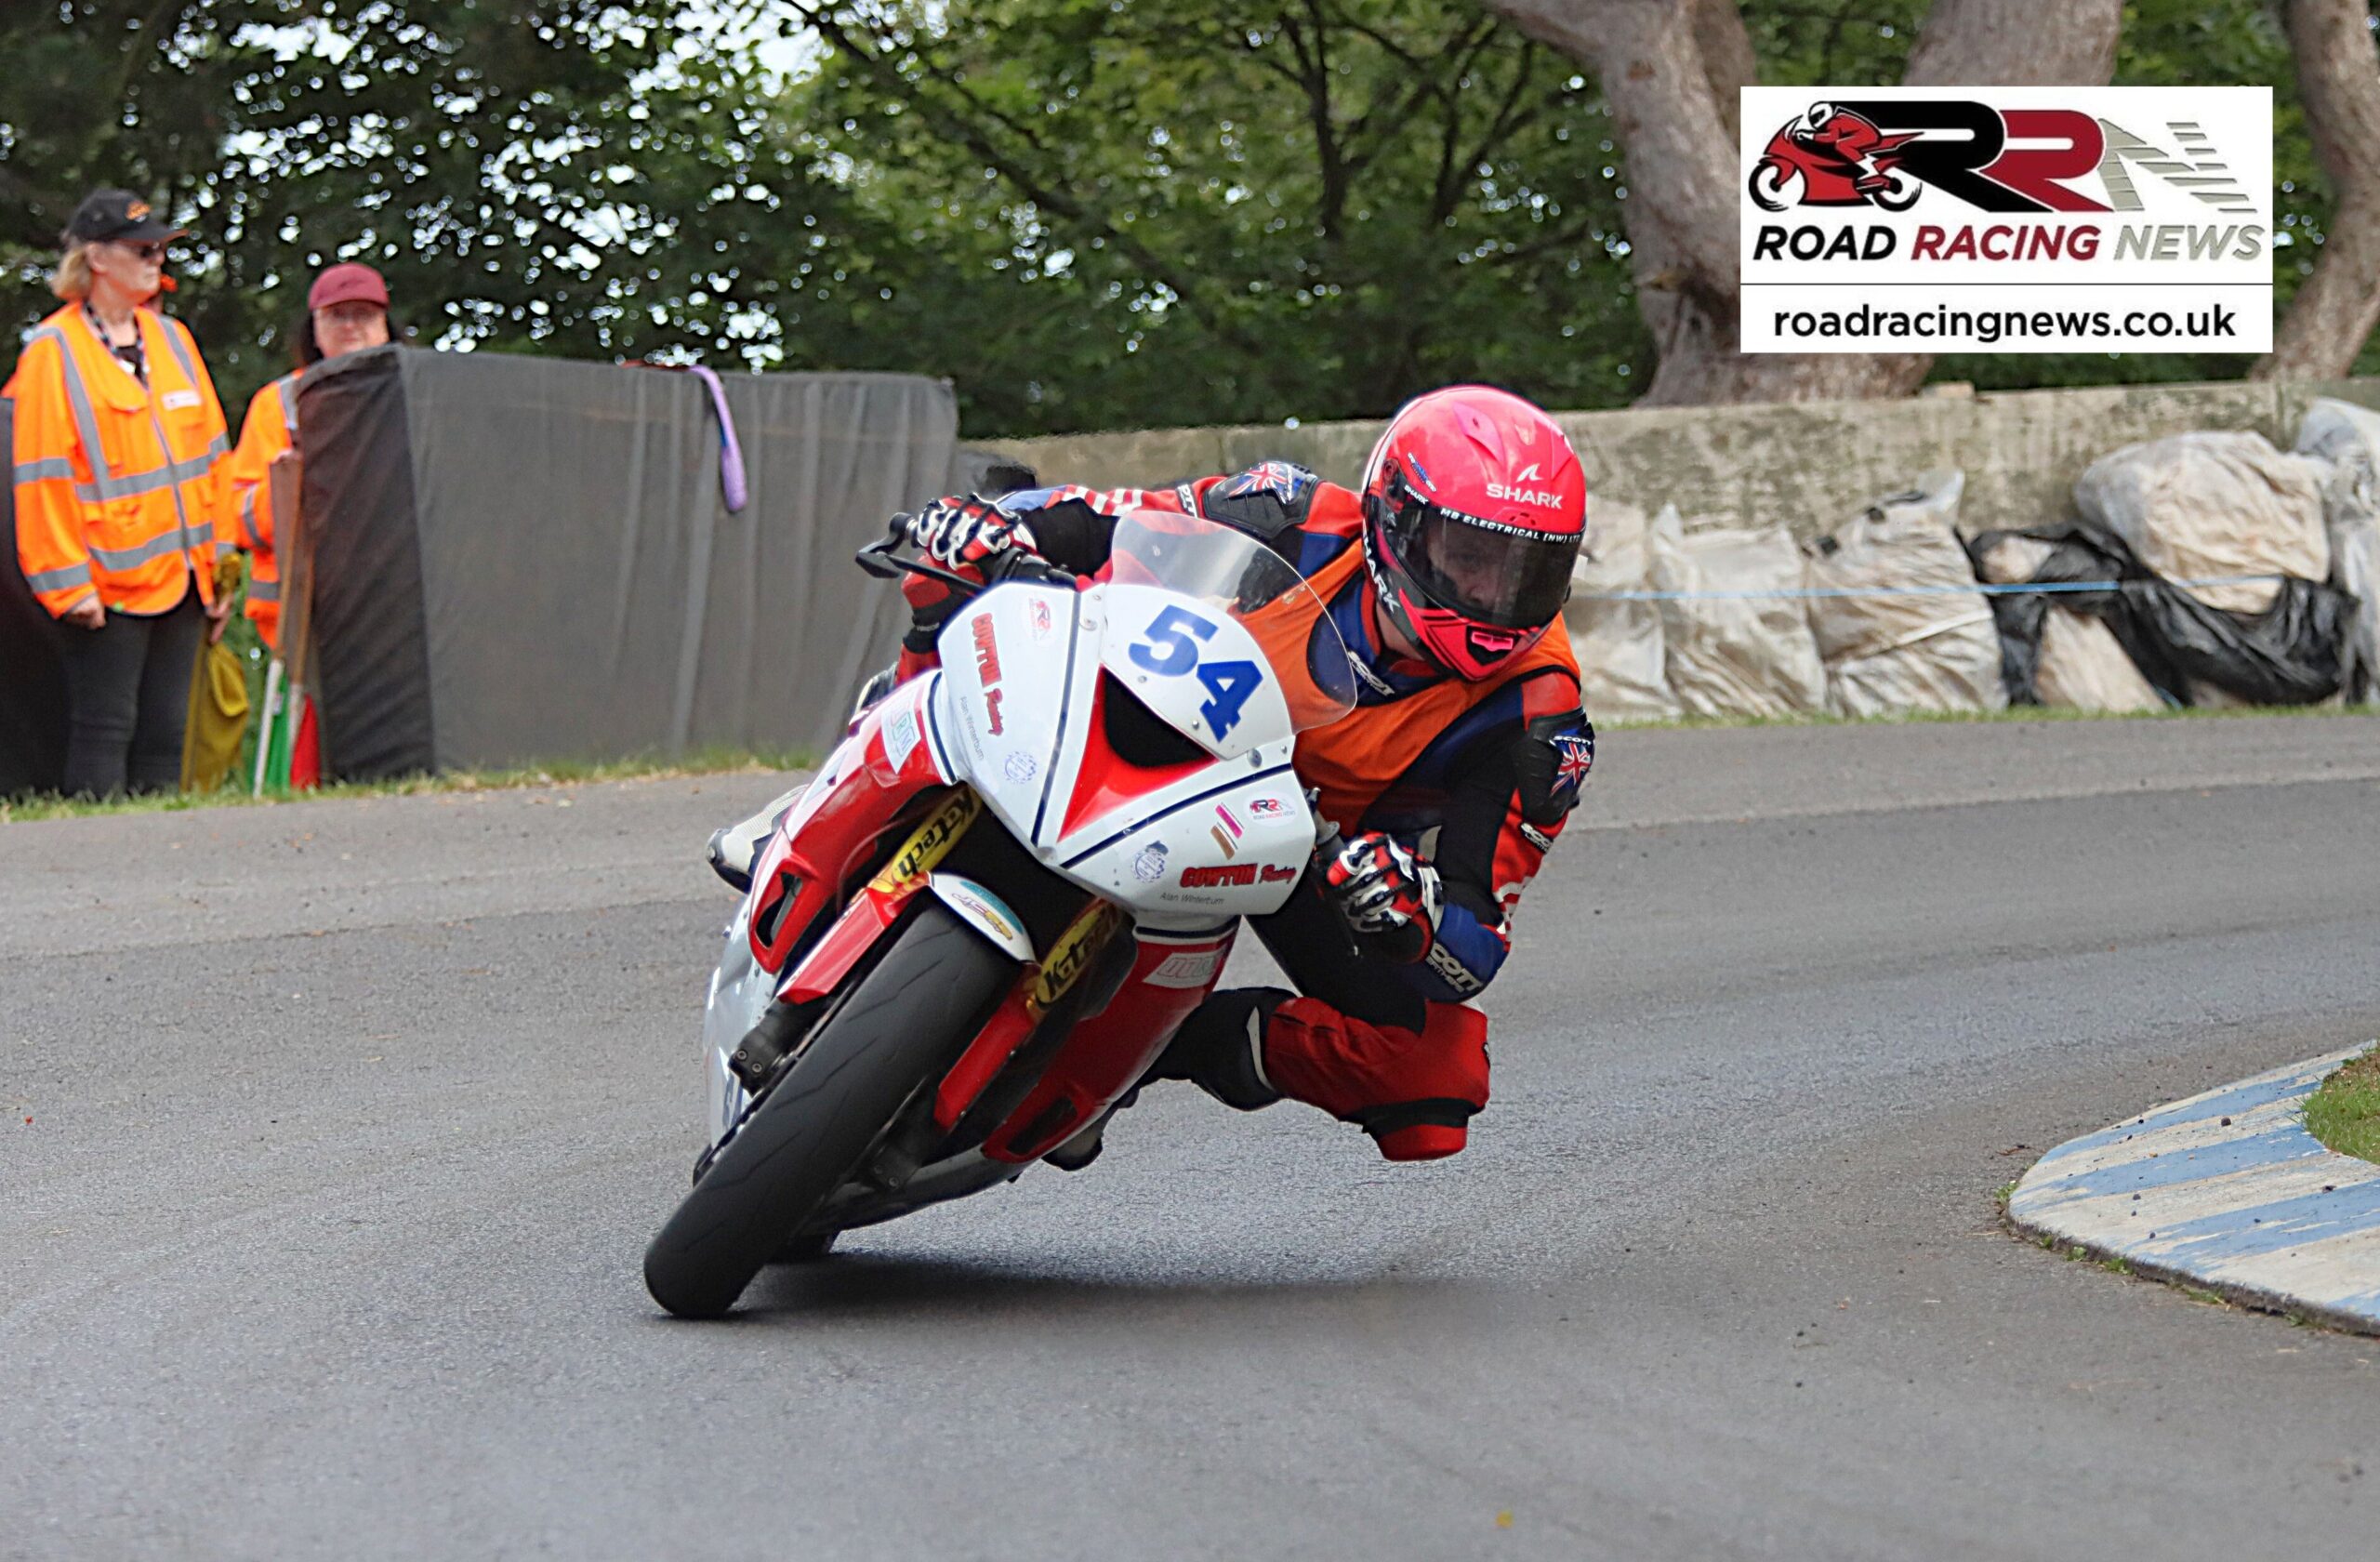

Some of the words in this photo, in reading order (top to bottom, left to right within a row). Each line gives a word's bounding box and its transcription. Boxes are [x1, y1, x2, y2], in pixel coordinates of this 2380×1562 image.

[1404, 483, 1429, 505] SHARK
[1486, 483, 1564, 510] SHARK
[1439, 507, 1460, 521] MB
[1461, 514, 1540, 540] ELECTRICAL
[1363, 536, 1401, 614] HARK
[1128, 603, 1264, 743] 54
[1179, 863, 1258, 889] COWTON
[1259, 863, 1298, 884] Racing
[1430, 942, 1484, 992] COTT
